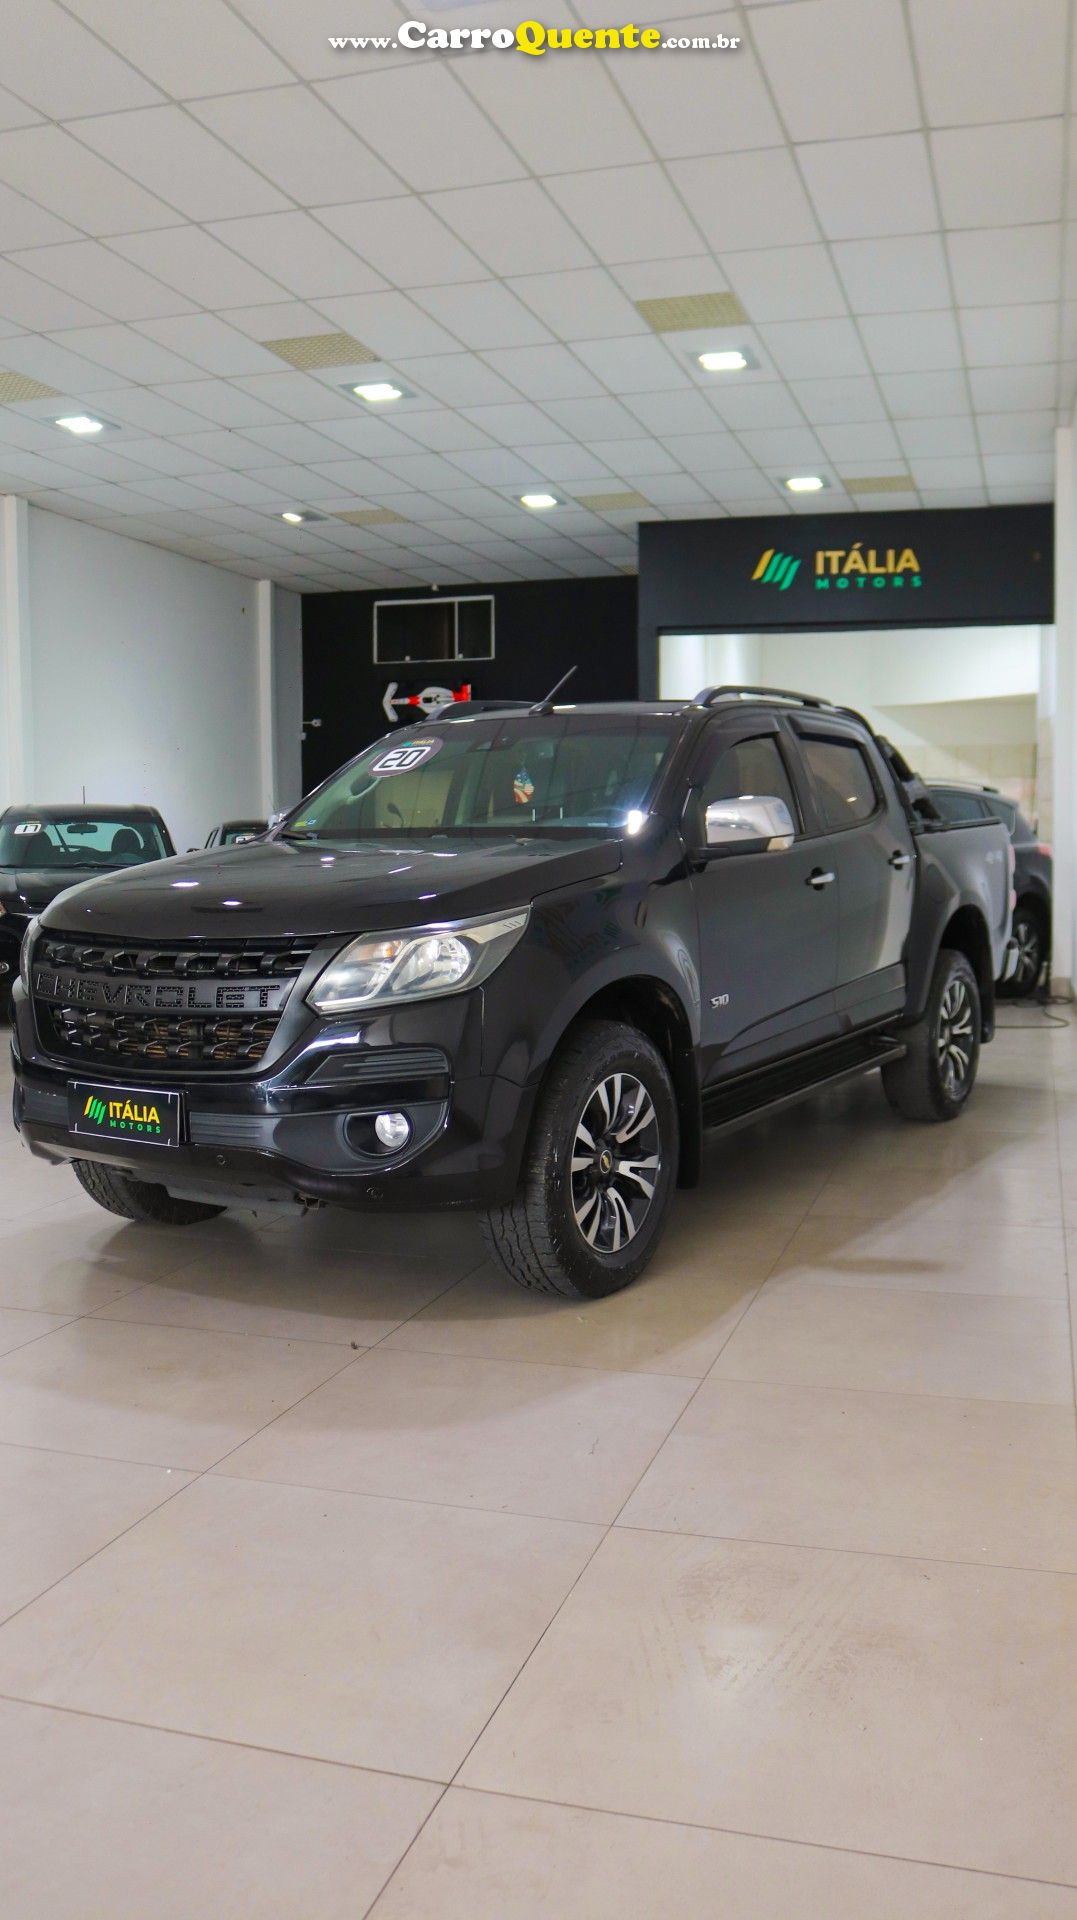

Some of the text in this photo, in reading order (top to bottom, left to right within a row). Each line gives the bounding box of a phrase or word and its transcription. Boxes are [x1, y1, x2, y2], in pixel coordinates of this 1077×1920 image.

[815, 542, 921, 575] ITÁLIA
[815, 576, 922, 589] MOTORS
[379, 749, 426, 768] 20
[36, 972, 281, 1008] CHEVROLET
[710, 993, 730, 1009] S10
[109, 1099, 160, 1124] ITÁLIA
[109, 1119, 161, 1134] MOTORS
